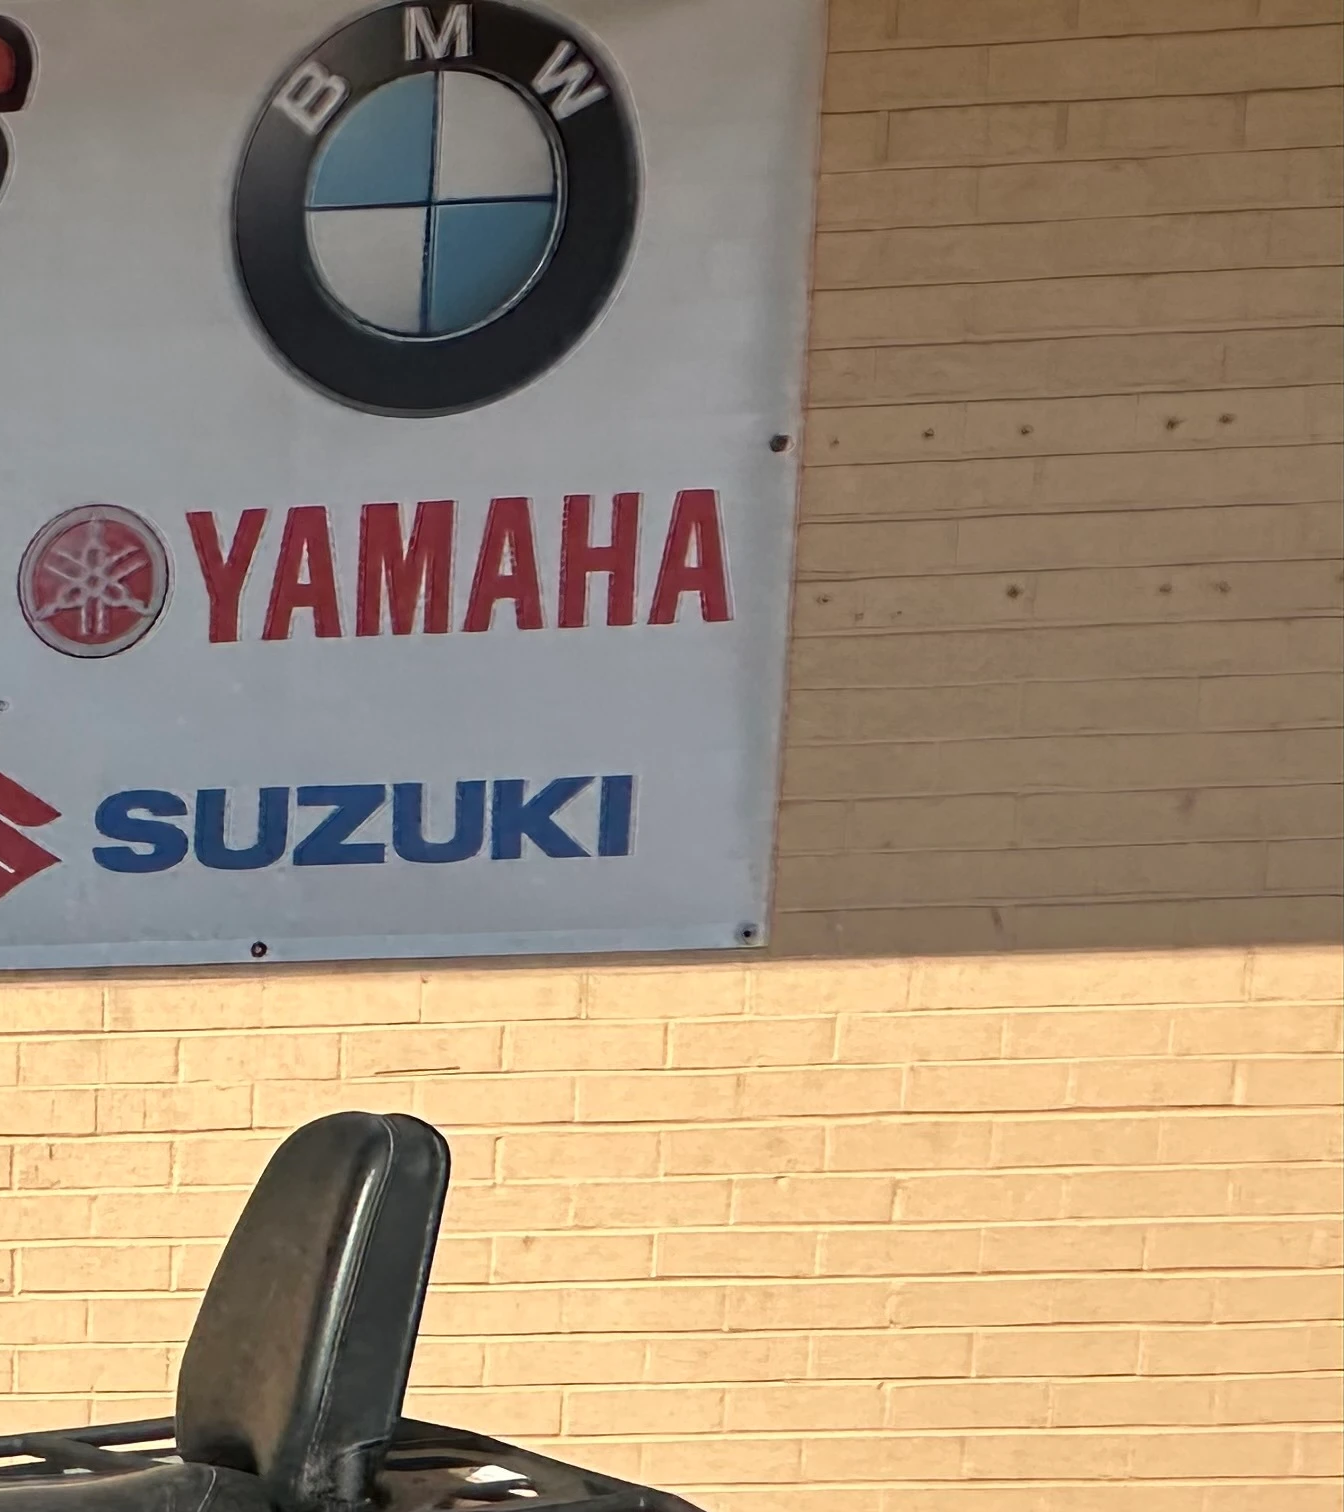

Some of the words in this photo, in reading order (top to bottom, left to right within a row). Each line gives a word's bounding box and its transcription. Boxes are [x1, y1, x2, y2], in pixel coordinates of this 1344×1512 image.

[274, 3, 610, 135] BMW
[185, 488, 734, 644] YAMAHA
[92, 775, 638, 873] SUZUKI
